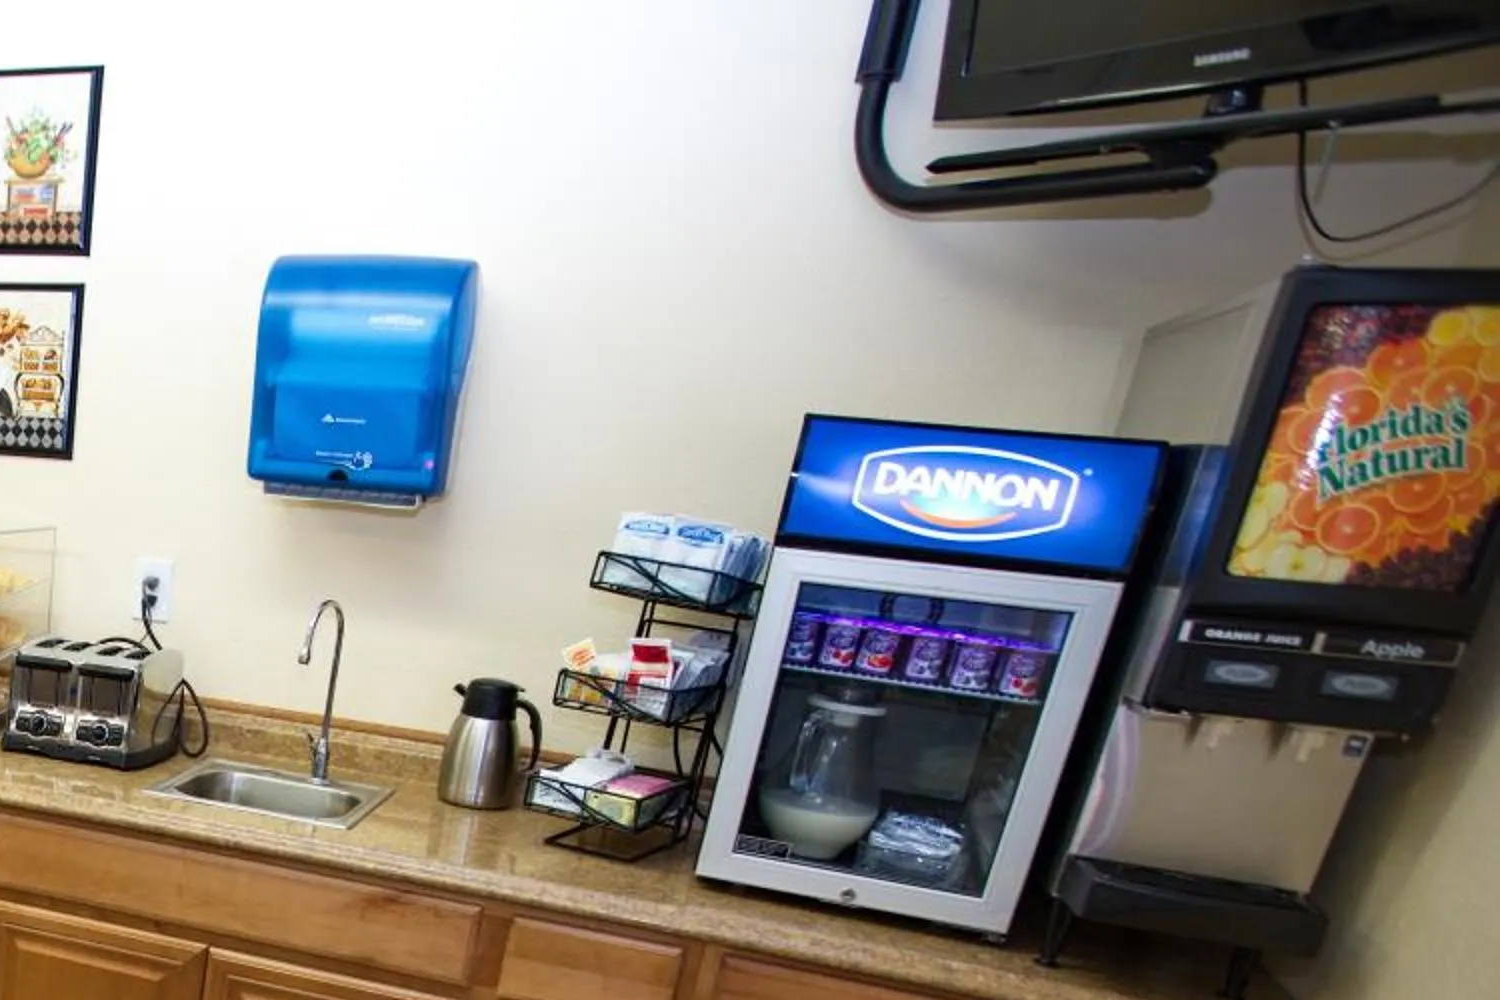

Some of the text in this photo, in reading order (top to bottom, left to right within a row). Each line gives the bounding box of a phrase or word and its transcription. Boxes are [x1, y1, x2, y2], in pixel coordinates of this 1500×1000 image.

[1316, 397, 1470, 463] lorida's
[872, 461, 1060, 512] DANNON
[1315, 437, 1467, 500] Natural
[1204, 627, 1263, 644] ORANGE
[1360, 638, 1427, 661] Apple
